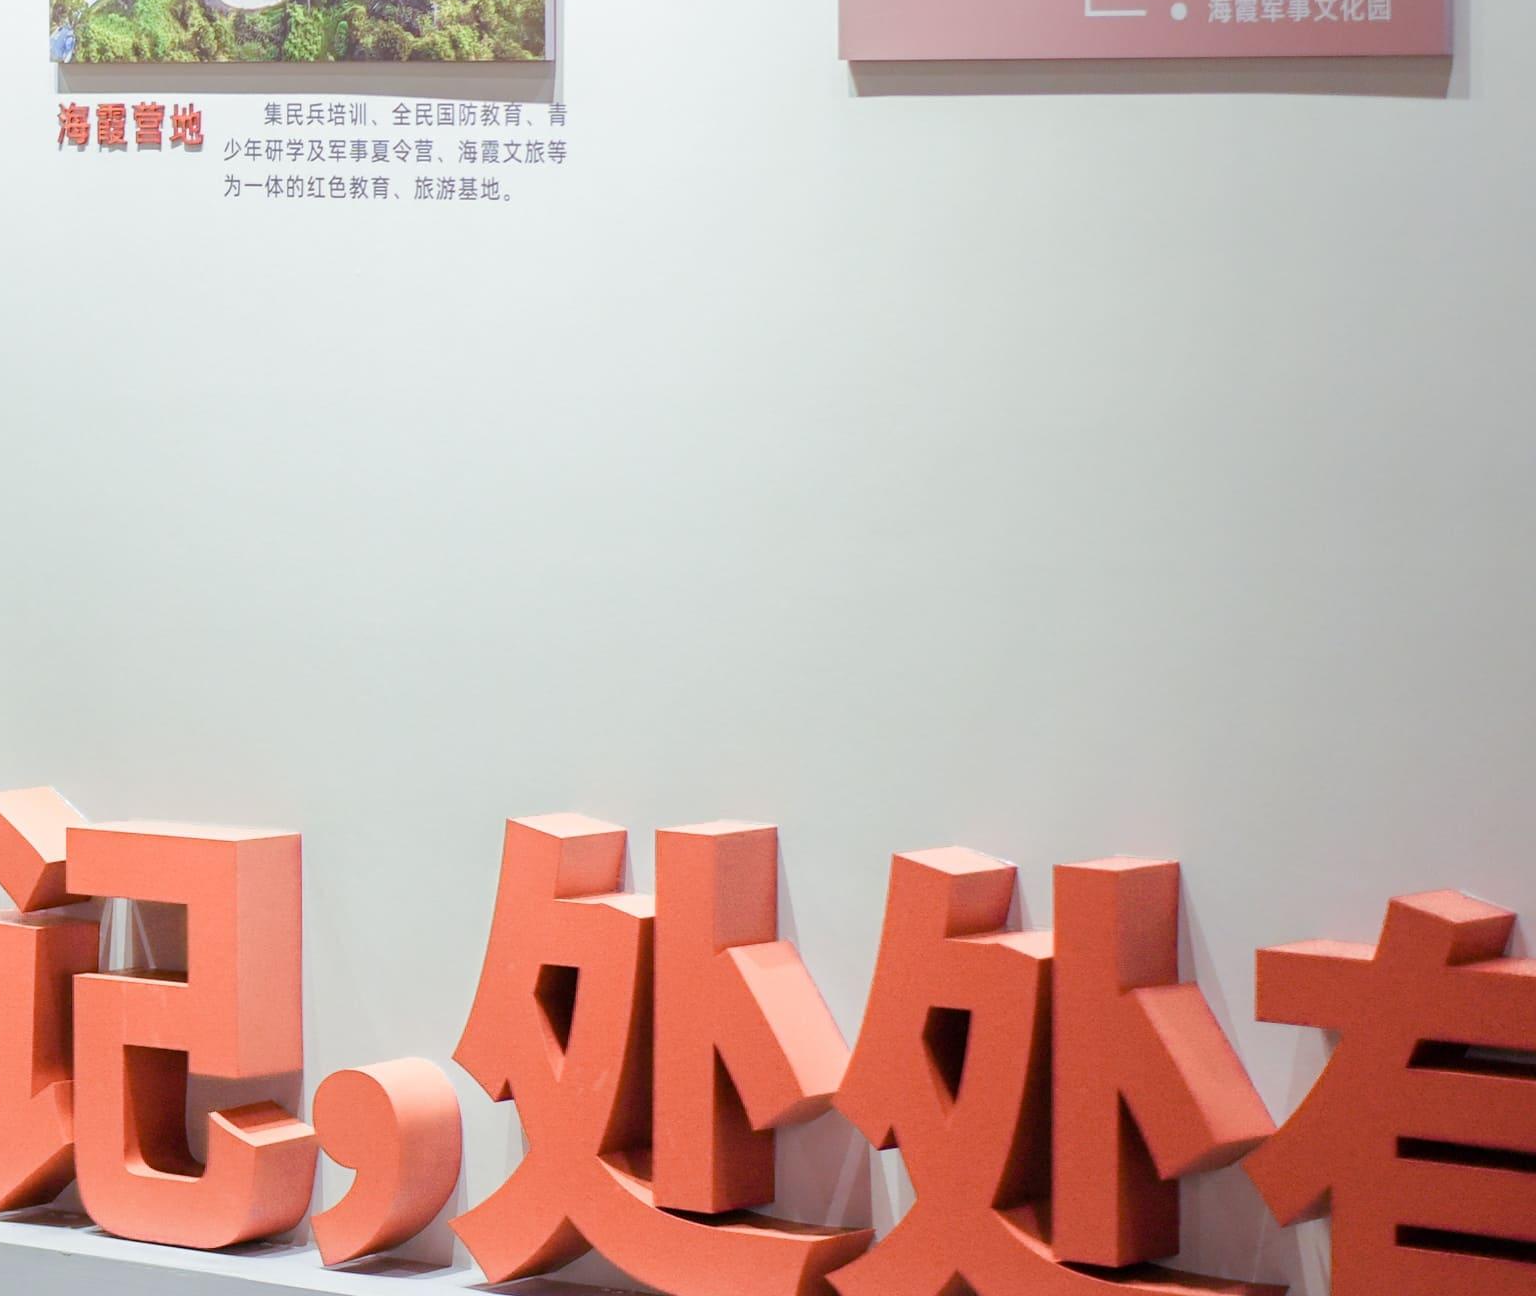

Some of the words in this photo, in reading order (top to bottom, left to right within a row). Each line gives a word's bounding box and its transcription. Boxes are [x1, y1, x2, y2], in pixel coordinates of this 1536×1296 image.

[57, 103, 205, 151] 海霞营地
[264, 101, 568, 128] 集民兵培训、全民国防教育、青
[224, 137, 568, 166] 少年研学及军事夏令营、海霞文旅等
[224, 174, 514, 203] 为一体的红色教育、旅游基地。
